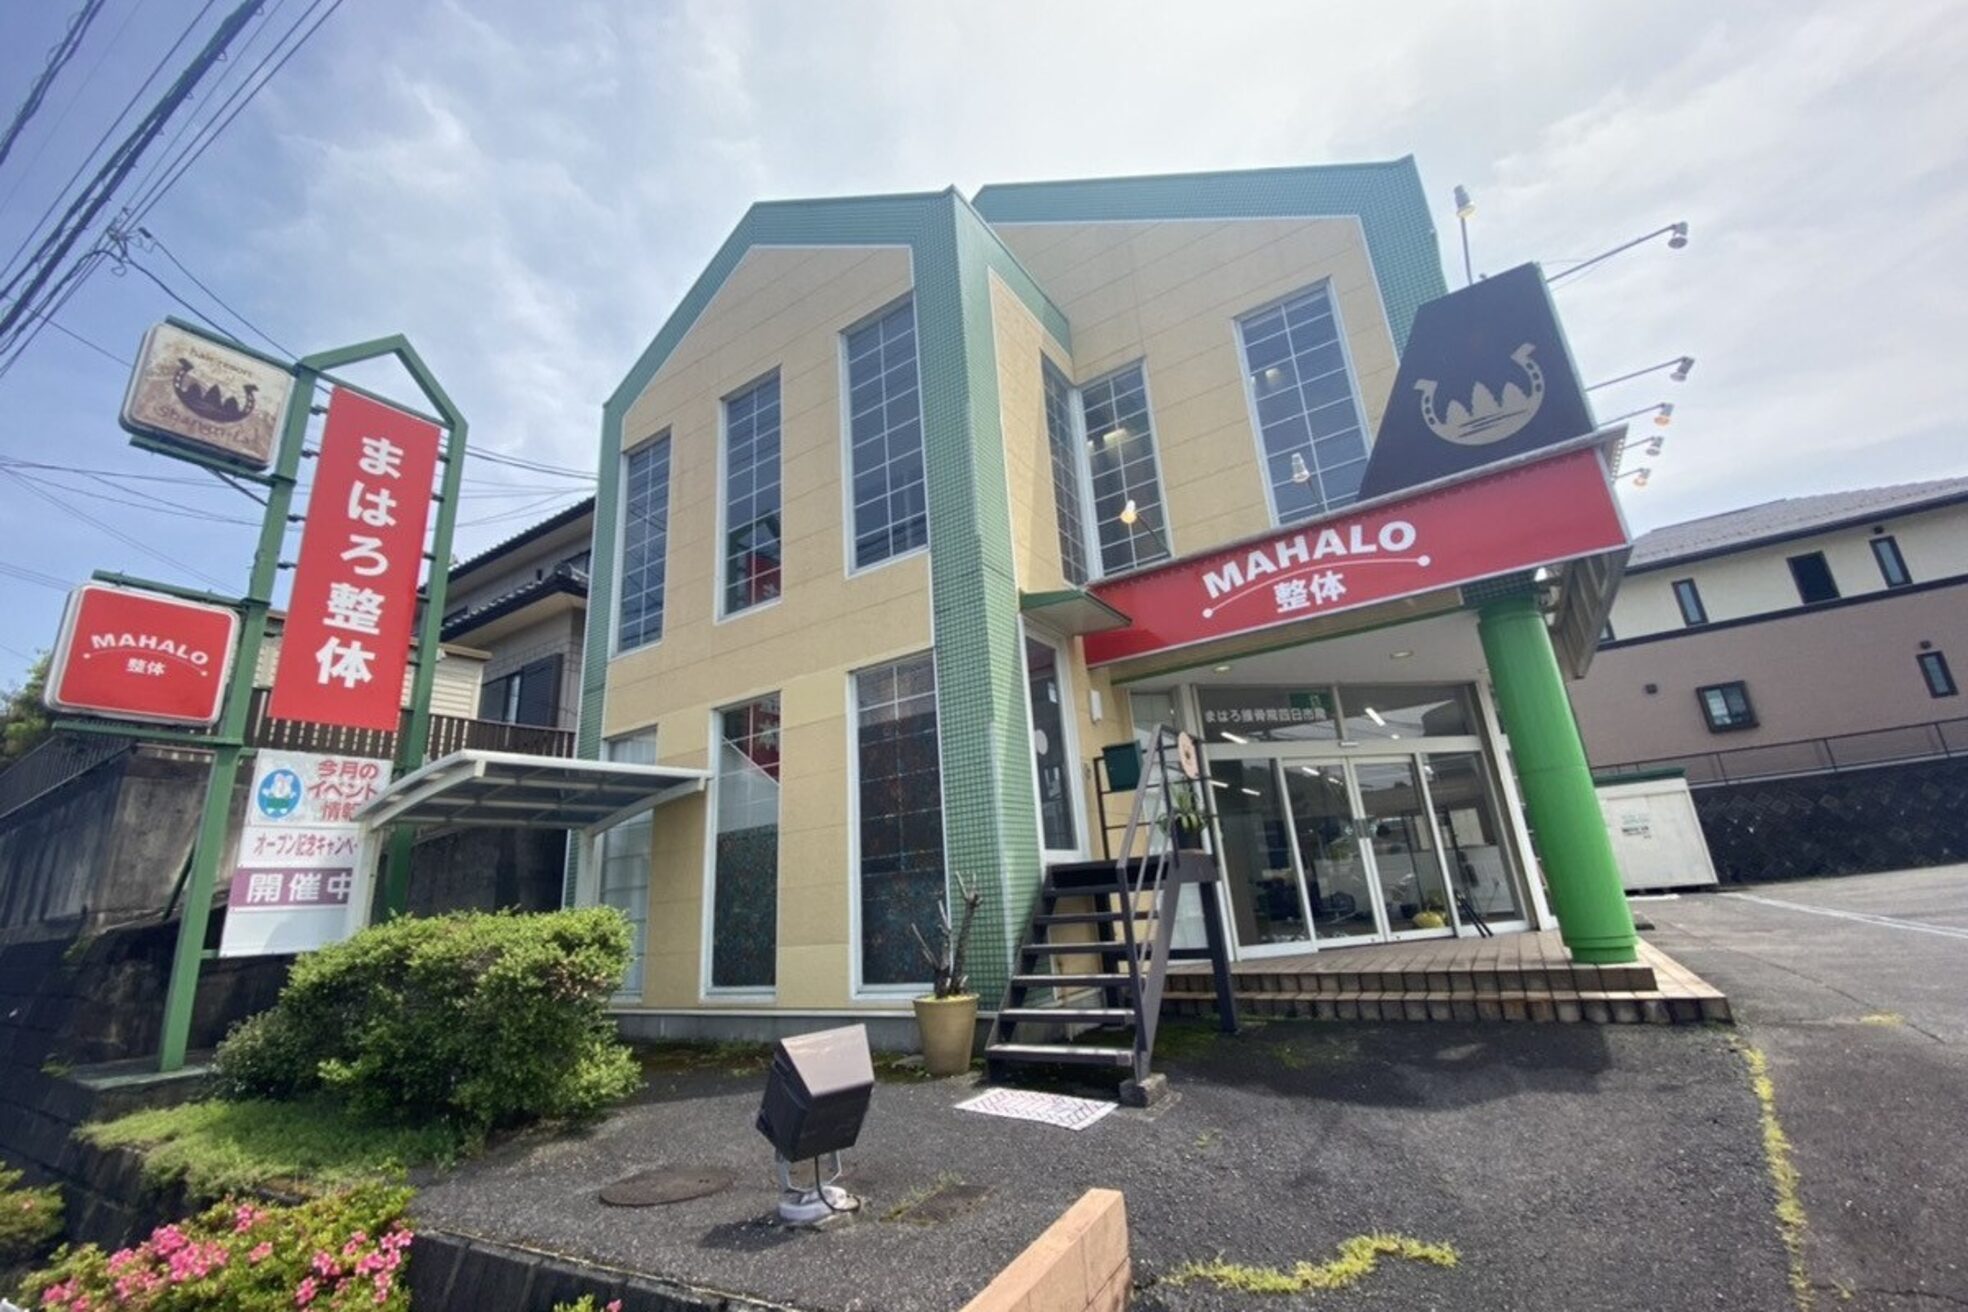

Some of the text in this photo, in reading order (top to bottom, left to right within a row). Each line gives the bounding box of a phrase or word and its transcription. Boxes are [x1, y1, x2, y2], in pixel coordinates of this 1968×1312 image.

[315, 436, 404, 689] まはろ整体
[1202, 521, 1417, 599] MAHALO
[1273, 570, 1347, 613] 整体
[91, 633, 209, 665] MAHALO
[126, 657, 166, 676] 整体
[318, 759, 379, 780] 今月の
[308, 780, 378, 799] イベント
[253, 832, 358, 857] オープン記念キャンペ
[246, 871, 350, 904] 開催中
